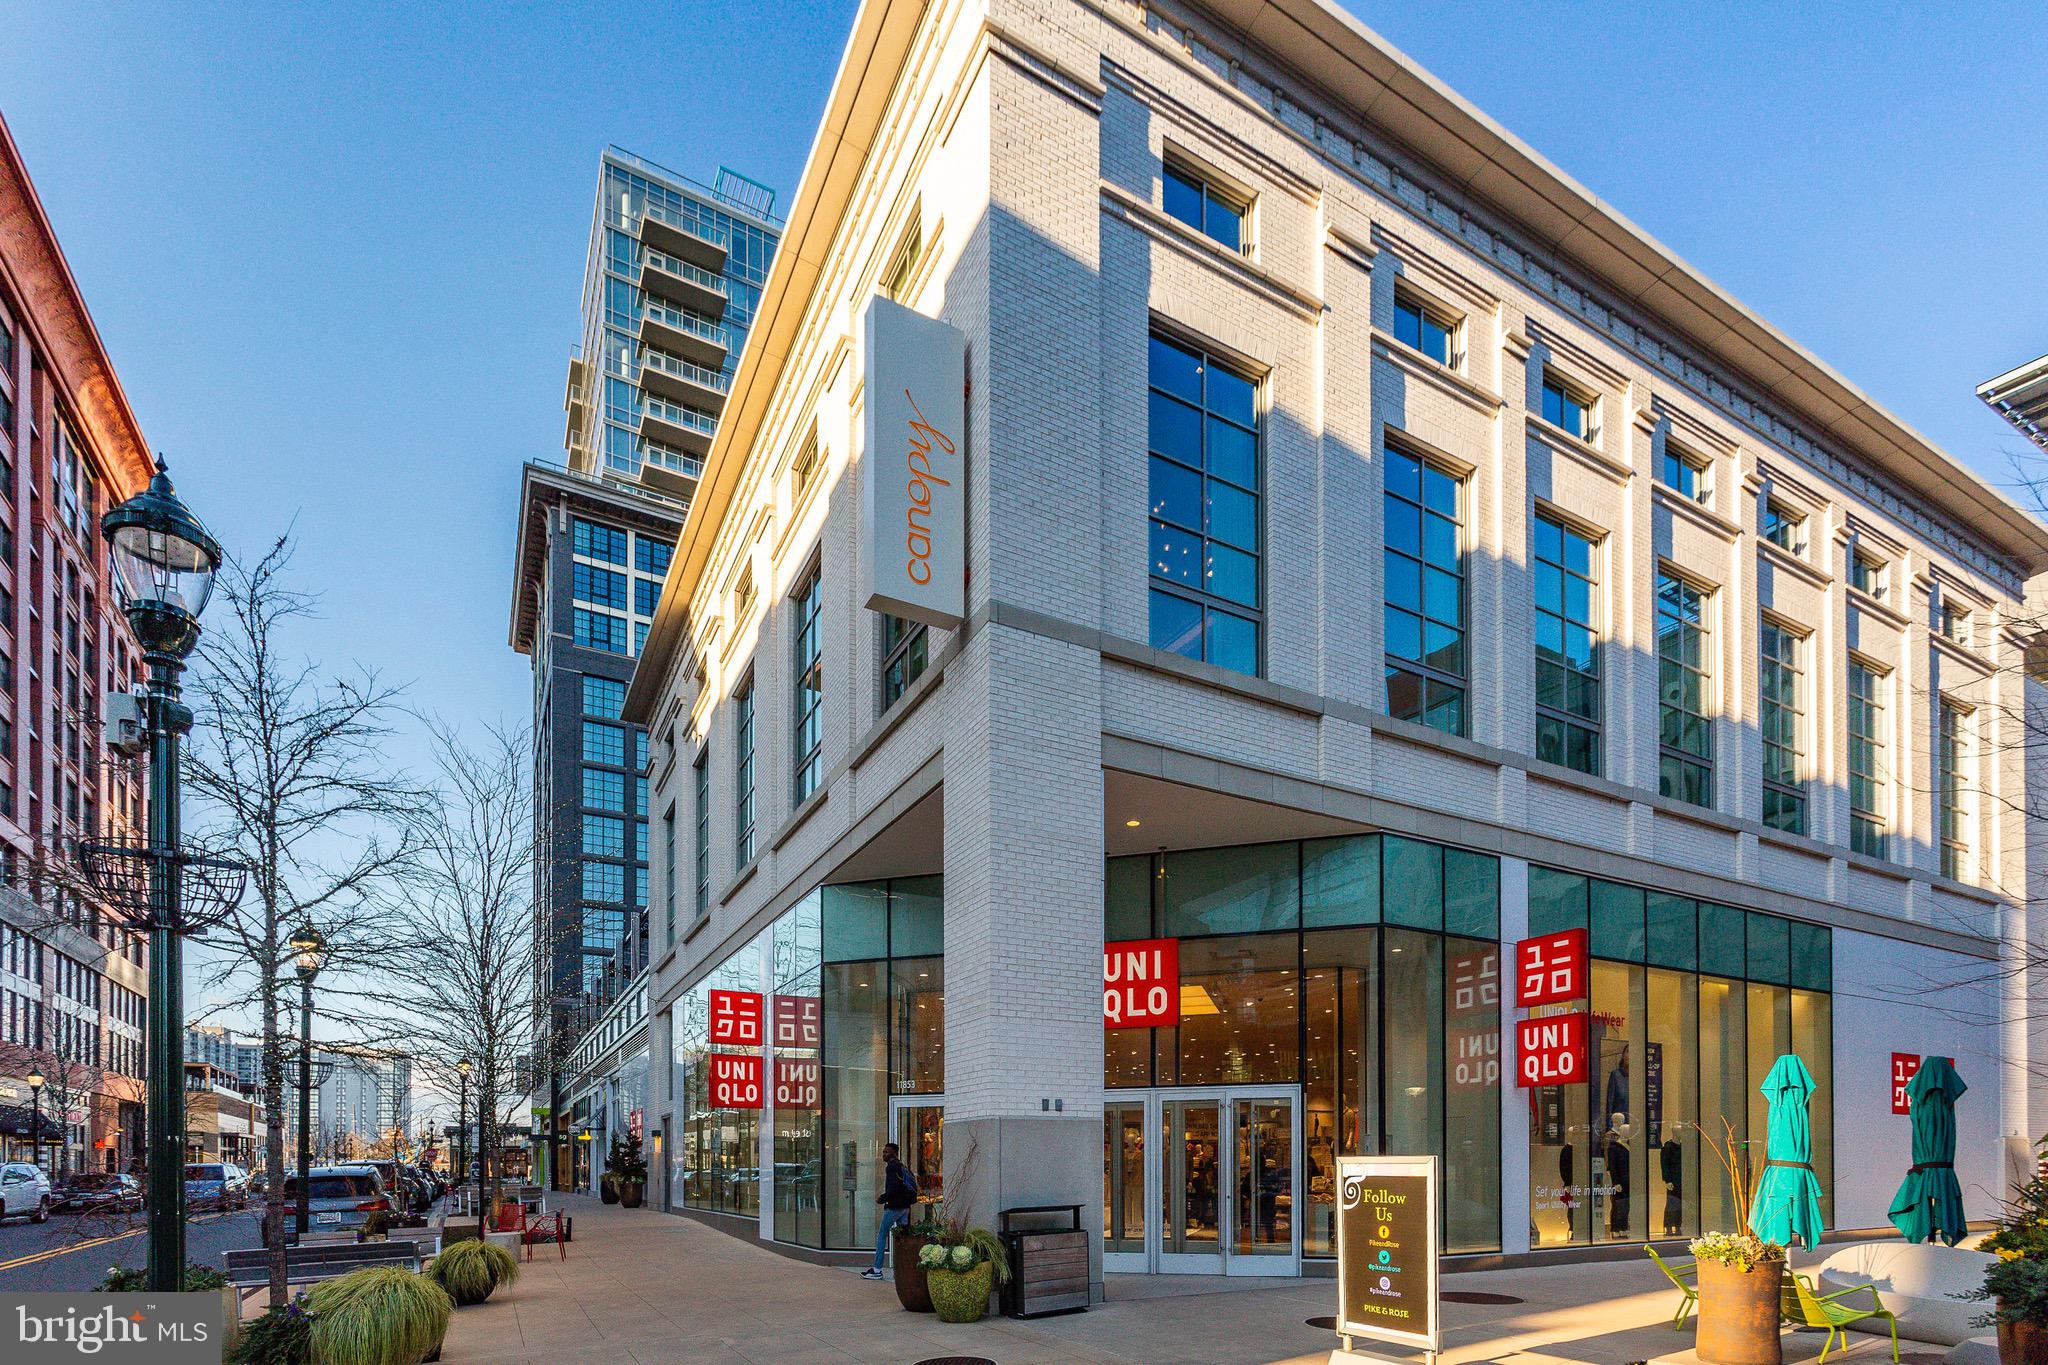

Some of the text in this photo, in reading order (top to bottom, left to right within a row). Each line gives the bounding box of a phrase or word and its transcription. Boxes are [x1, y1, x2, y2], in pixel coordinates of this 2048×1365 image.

[906, 388, 956, 585] canopy
[1104, 950, 1161, 982] UNI
[1104, 986, 1168, 1023] QLO
[1524, 1023, 1569, 1050] UNI
[717, 1060, 754, 1081] UNI
[1524, 1051, 1574, 1082] QLO
[717, 1083, 758, 1105] QLO
[896, 1080, 916, 1089] 11853
[1363, 1189, 1407, 1204] Follow
[1536, 1184, 1617, 1200] Set your life in motion
[1375, 1207, 1393, 1222] Us
[1364, 1304, 1410, 1318] PIKE & ROSE
